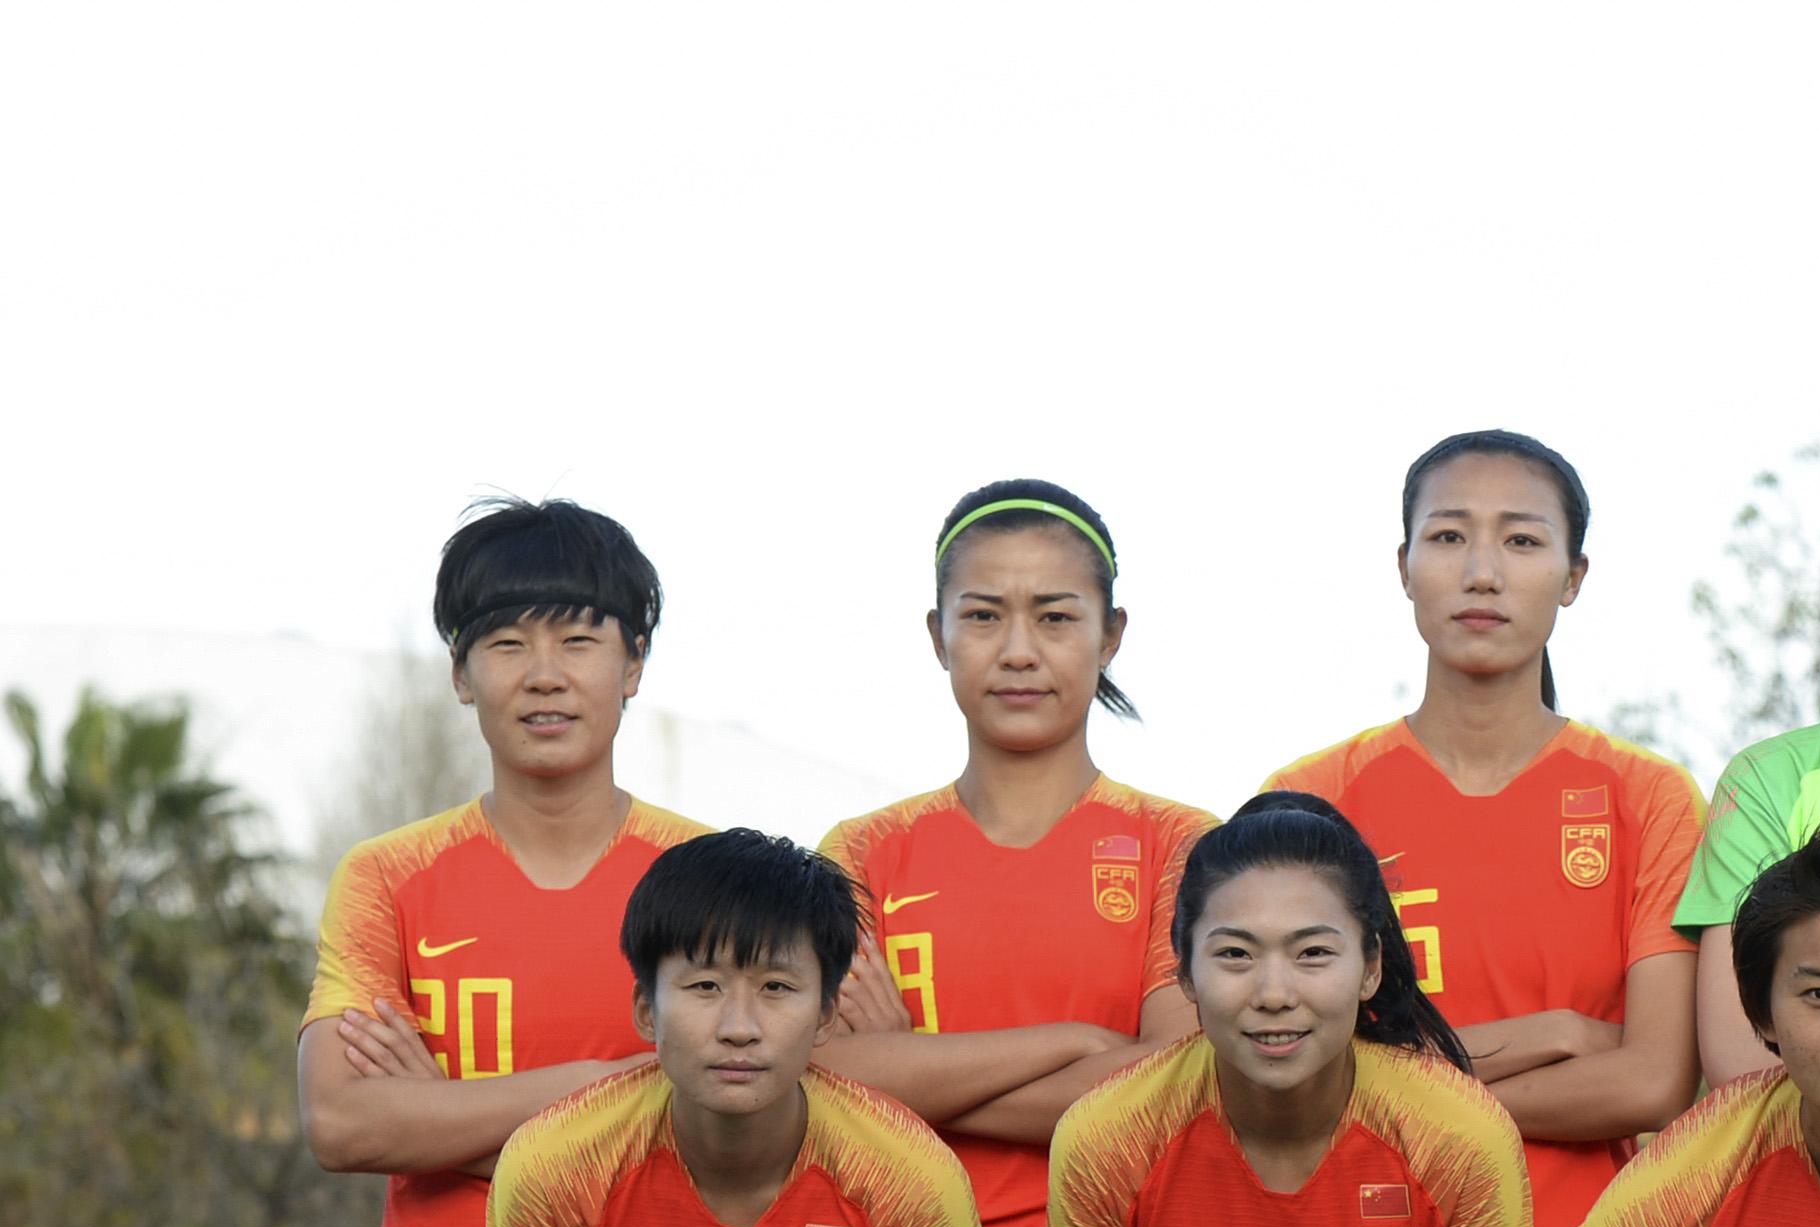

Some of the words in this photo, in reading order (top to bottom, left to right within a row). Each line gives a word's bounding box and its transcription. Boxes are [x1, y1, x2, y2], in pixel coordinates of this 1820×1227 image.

[1567, 828, 1606, 840] CFA
[1097, 868, 1136, 882] CFA
[408, 977, 513, 1080] 20
